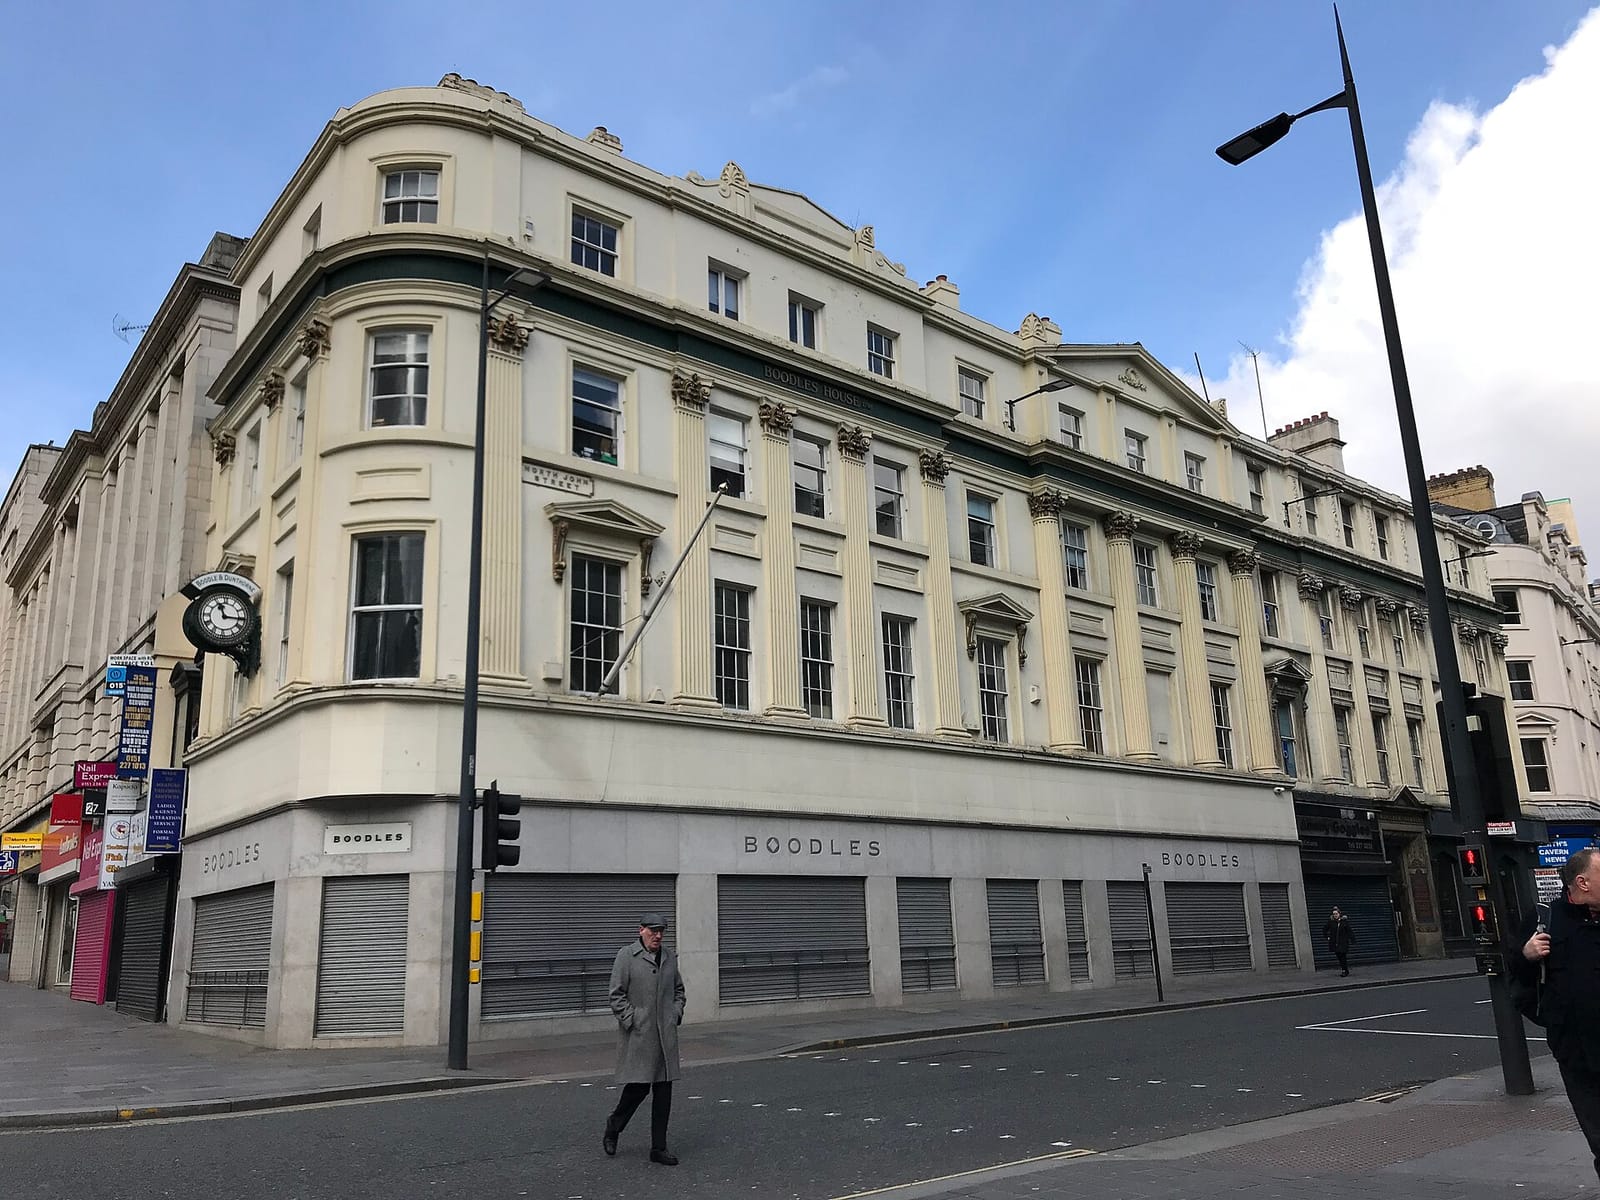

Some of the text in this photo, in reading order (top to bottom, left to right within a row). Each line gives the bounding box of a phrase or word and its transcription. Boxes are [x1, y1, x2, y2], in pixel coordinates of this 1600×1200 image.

[764, 365, 860, 407] BOODLES HOUSE
[524, 464, 589, 485] NORTH JOHN
[534, 475, 580, 491] STREET
[77, 763, 97, 772] Nail
[333, 833, 403, 843] BOODLES
[744, 836, 880, 857] BOODLES
[204, 843, 259, 873] BOODLES
[1161, 852, 1239, 867] BOODLES
